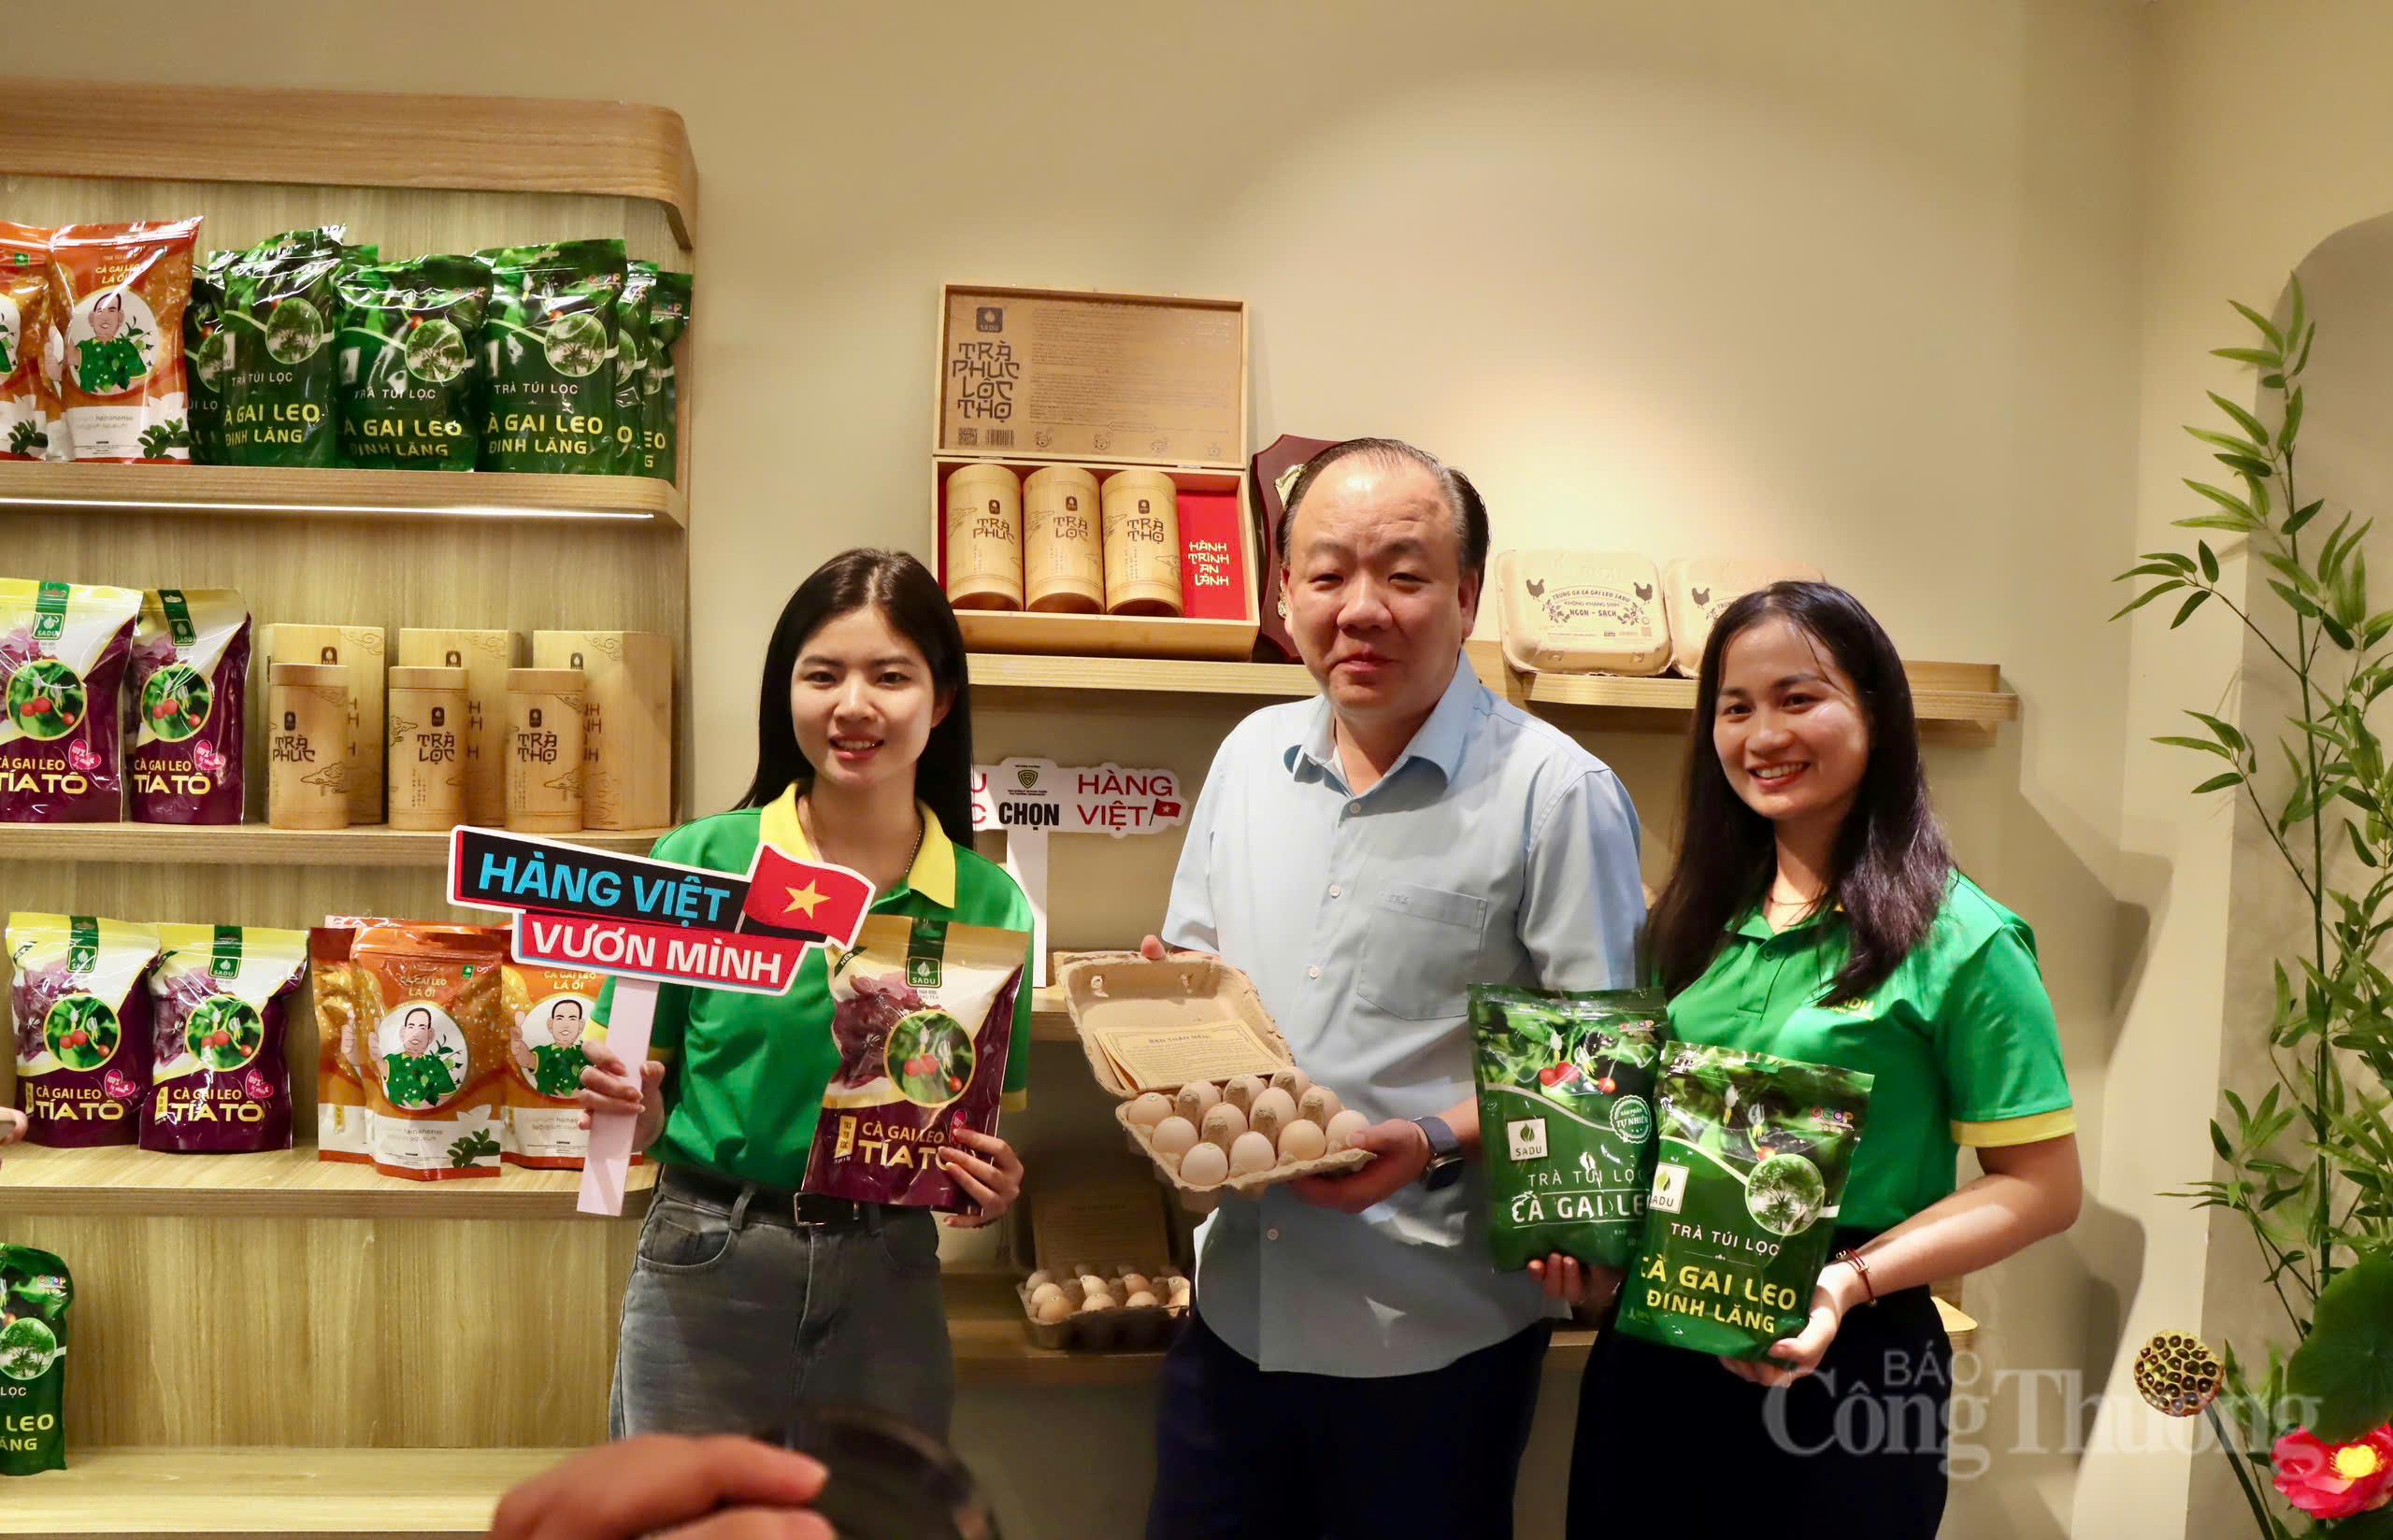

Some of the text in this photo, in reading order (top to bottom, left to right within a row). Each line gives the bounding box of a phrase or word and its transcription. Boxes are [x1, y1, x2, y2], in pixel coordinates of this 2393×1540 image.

[958, 340, 1011, 362] TRÀ
[952, 357, 1020, 379] PHÚC
[269, 372, 293, 384] LỌC
[408, 389, 436, 401] LỌC
[494, 381, 516, 395] TRÀ
[523, 380, 544, 393] TÚI
[962, 376, 1013, 403] LỘC
[236, 404, 264, 423] GAI
[273, 403, 320, 422] LEO
[957, 399, 1012, 423] THỌ
[363, 420, 403, 437] GAI
[414, 420, 462, 437] LEO
[505, 414, 540, 433] GAI
[556, 416, 603, 435] LEO
[253, 426, 303, 444] LĂNG
[395, 442, 449, 457] LĂNG
[535, 436, 587, 455] LĂNG
[977, 517, 1010, 532] TRÀ
[1053, 516, 1088, 531] TRÀ
[1126, 517, 1164, 532] TRÀ
[1127, 529, 1165, 545] THỌ
[1188, 539, 1227, 552] HÀNH
[1188, 552, 1230, 565] TRÌNH
[1199, 563, 1220, 574] AN
[1195, 573, 1229, 587] LÀNH
[275, 734, 308, 750] TRÀ
[417, 732, 455, 748] TRÀ
[517, 731, 558, 749] TRÀ
[272, 746, 316, 763] PHÚC
[419, 747, 455, 765] LỘC
[517, 747, 558, 765] THỌ
[12, 758, 36, 769] GAI
[39, 760, 65, 771] LEO
[134, 758, 192, 772] CÀ GAI LEO
[0, 769, 88, 795] TÍA TÔ
[134, 771, 211, 795] TÍA TÔ
[1077, 769, 1174, 797] HÀNG
[998, 802, 1060, 831] CHỌN
[1077, 800, 1148, 832] VIỆT
[479, 852, 730, 927] HÀNG VIỆT
[531, 921, 782, 984] VƯƠN MÌNH
[840, 951, 854, 966] NEW
[431, 978, 448, 987] LEO
[911, 977, 937, 985] SADU
[36, 1085, 50, 1098] CÀ
[51, 1088, 74, 1100] GAI
[76, 1089, 102, 1100] LEO
[173, 1087, 191, 1100] CÀ
[193, 1089, 214, 1100] GAI
[217, 1090, 242, 1100] LEO
[35, 1099, 124, 1120] TÍA TÔ
[219, 1100, 265, 1122] TÔ
[862, 1120, 945, 1145] CÀ GAI LEO
[858, 1137, 914, 1169] TÍA
[1515, 1146, 1542, 1157] SADU
[1527, 1168, 1563, 1188] TRÀ
[1556, 1194, 1603, 1219] GAI
[1616, 1192, 1651, 1217] LE
[1651, 1195, 1673, 1207] ADU
[1670, 1221, 1780, 1258] TRÀ TÚI LỌC
[1679, 1265, 1733, 1296] GAI
[1744, 1278, 1797, 1311] LEO
[1646, 1289, 1774, 1333] ĐINH LĂNG
[0, 1386, 27, 1399] LỌC
[6, 1413, 54, 1432] LEO
[0, 1435, 37, 1451] ĂNG
